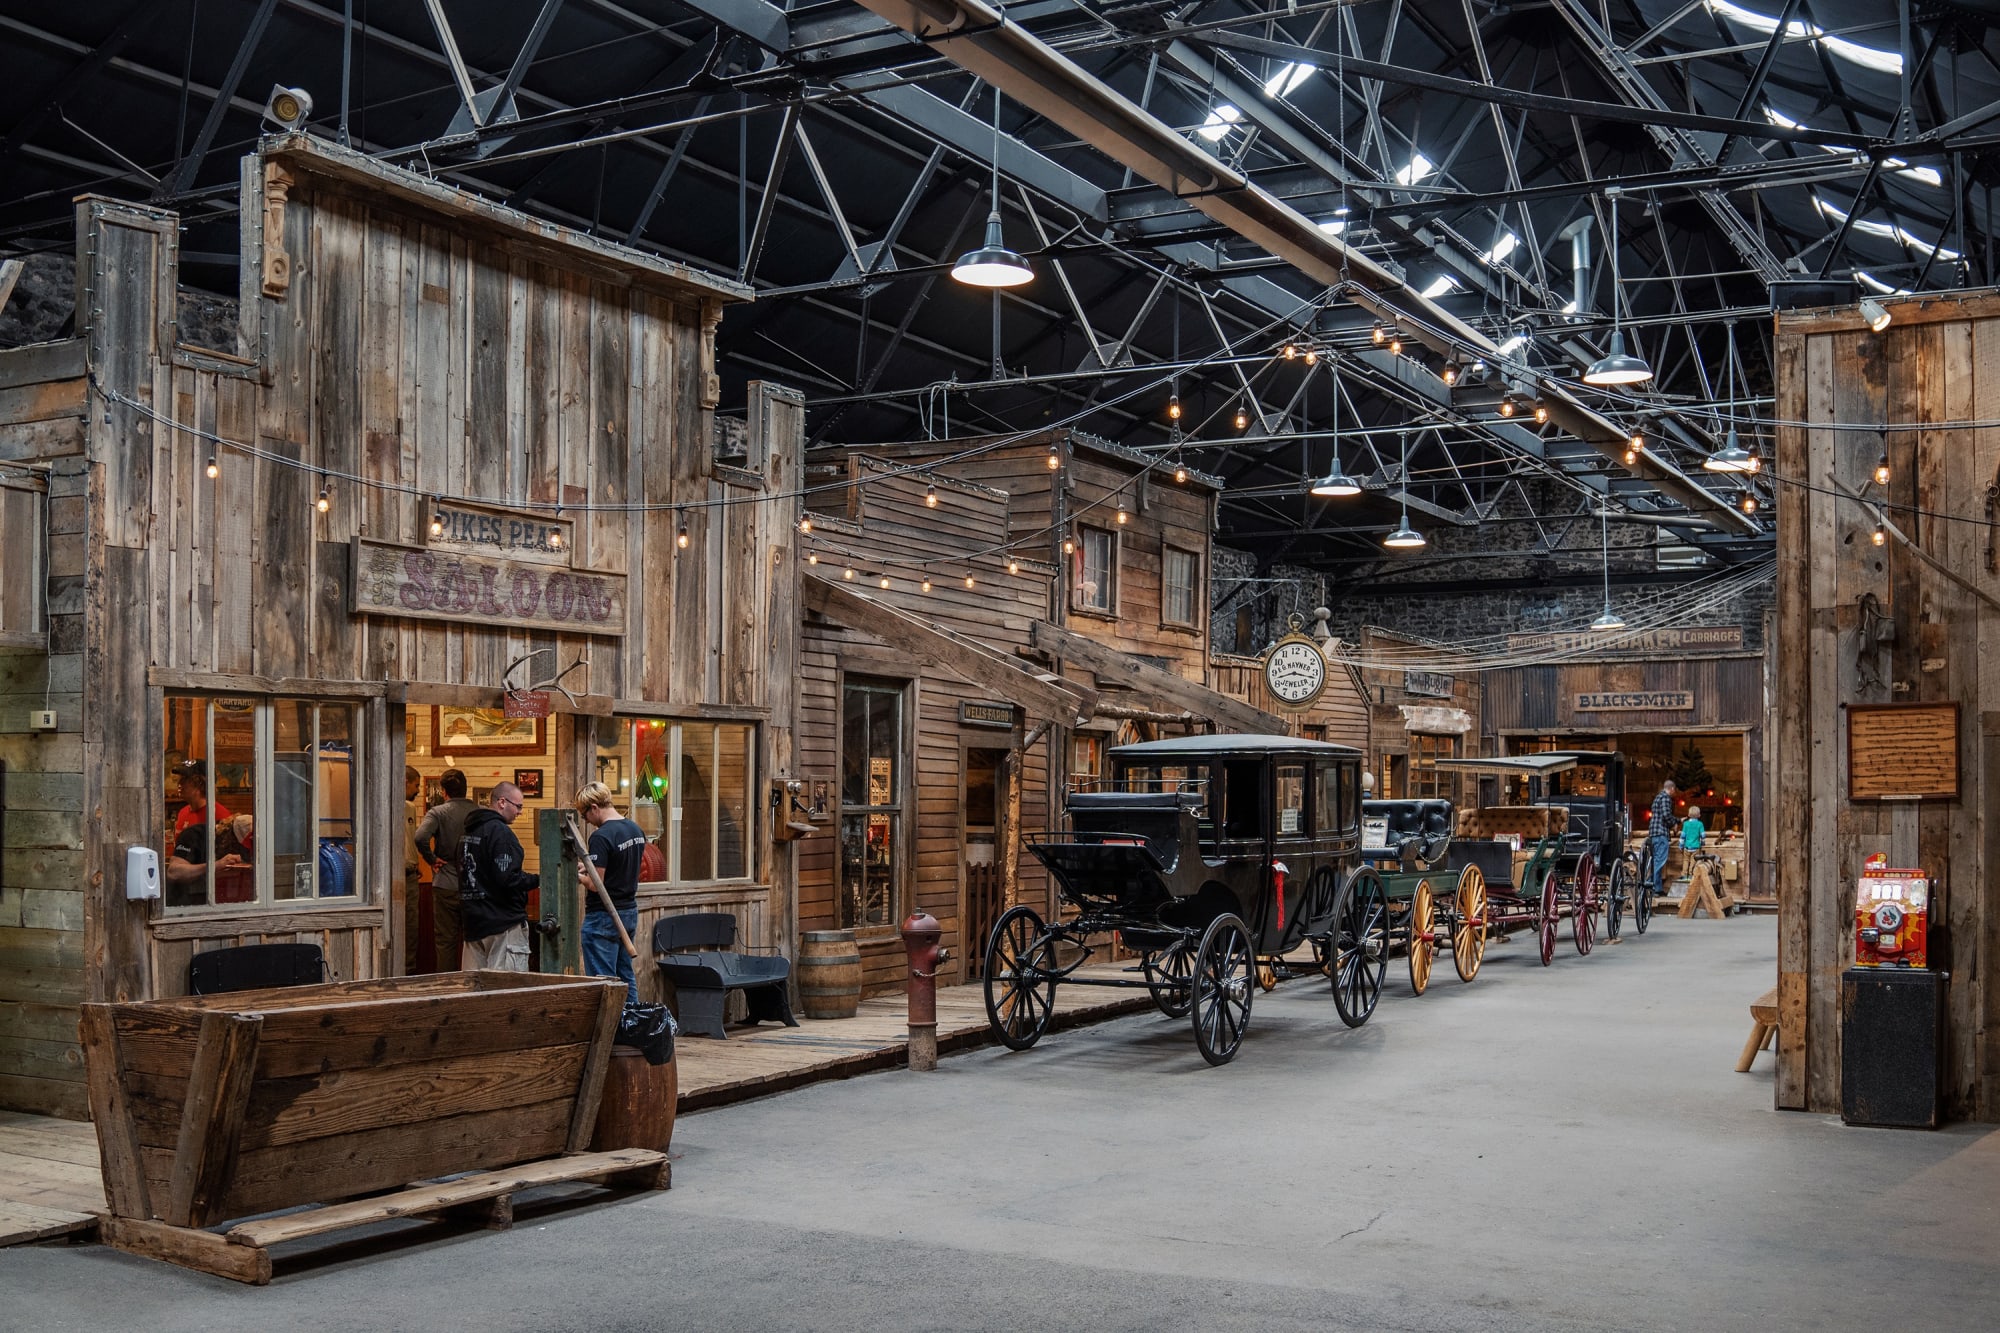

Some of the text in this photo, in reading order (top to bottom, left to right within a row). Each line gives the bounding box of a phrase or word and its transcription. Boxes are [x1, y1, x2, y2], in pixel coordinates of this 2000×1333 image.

[436, 510, 502, 543] PIKES
[400, 551, 611, 621] SALOON
[1682, 631, 1741, 643] CARRIAGES
[1282, 650, 1288, 658] 11
[1274, 658, 1283, 666] 10
[1274, 680, 1280, 688] 8
[1281, 678, 1308, 687] JEWELER
[1282, 688, 1288, 696] 7
[1579, 693, 1687, 707] BLACKSMITH
